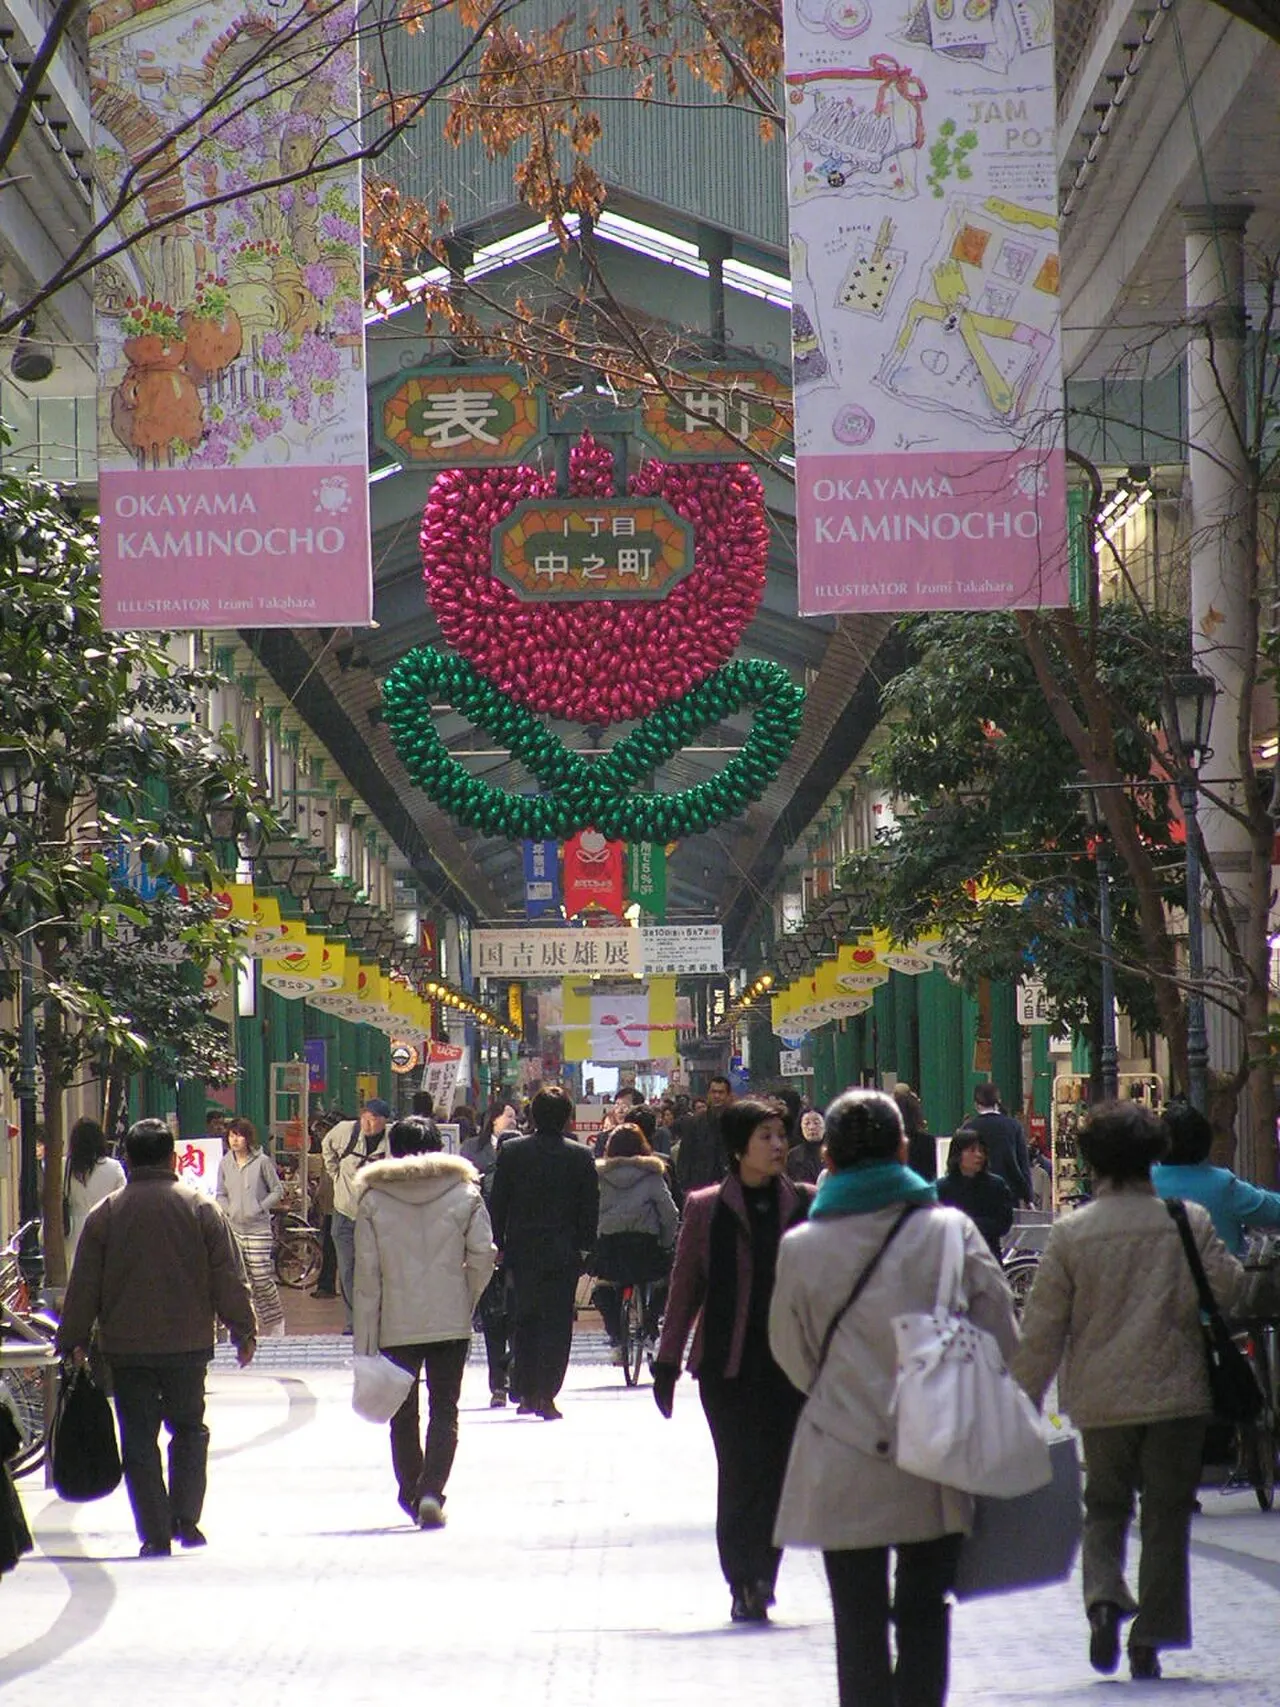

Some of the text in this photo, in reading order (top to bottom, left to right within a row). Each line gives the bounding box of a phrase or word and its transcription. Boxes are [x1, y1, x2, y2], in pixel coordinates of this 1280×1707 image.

[423, 388, 498, 449] 表
[813, 476, 954, 503] OKAYAMA
[115, 492, 257, 518] OKAYAMA
[814, 509, 1042, 543] KAMINOCHO
[117, 526, 345, 560] KAMINOCHO
[534, 547, 653, 582] 中之町
[815, 578, 1014, 598] ILLUSTRATOR Izumi Takahara
[117, 599, 210, 613] ILLUSTRATOR
[218, 597, 254, 611] Izumi
[480, 941, 629, 967] 国吉康雄展
[178, 1144, 205, 1177] 肉
